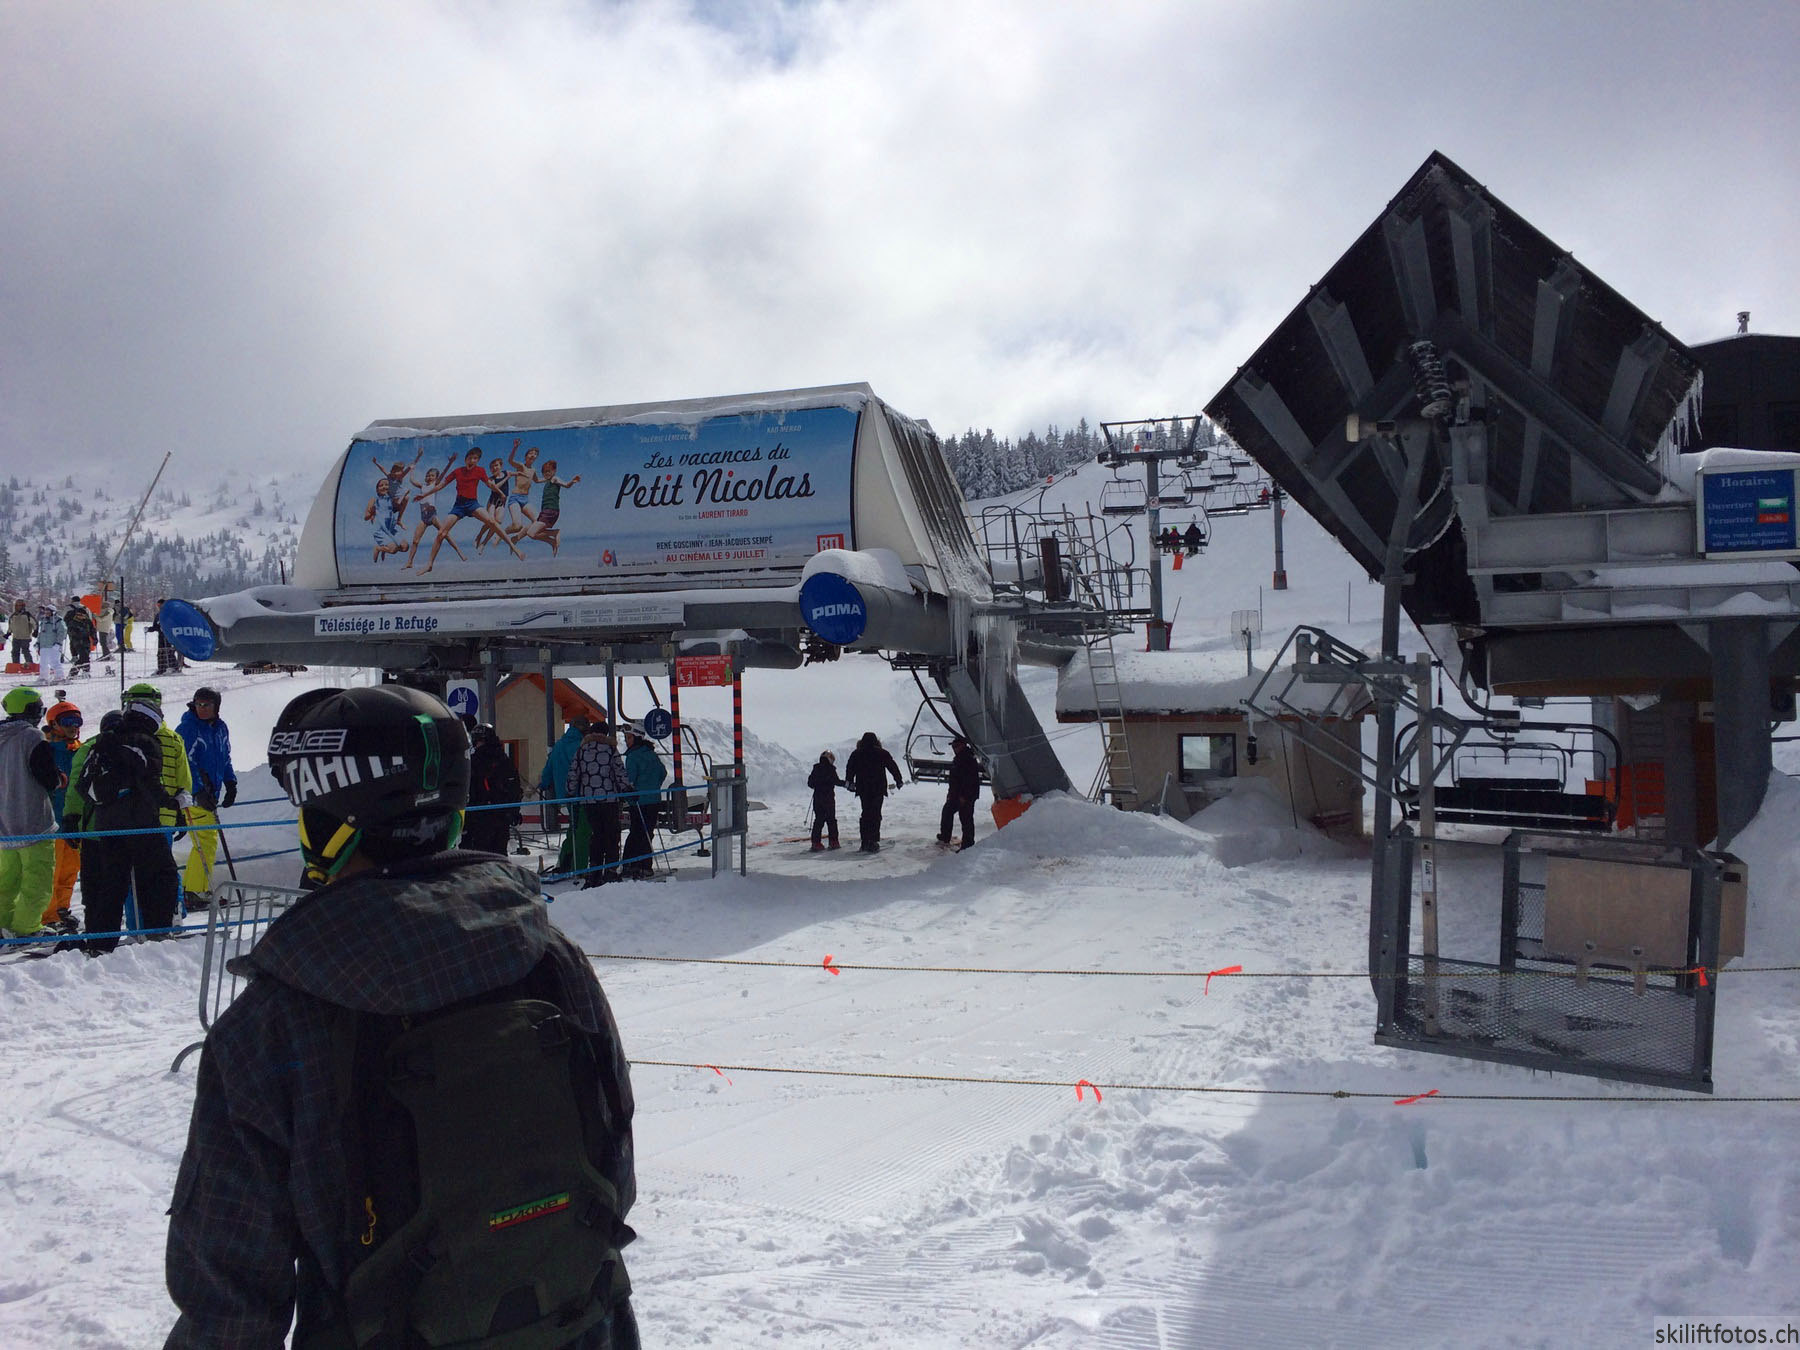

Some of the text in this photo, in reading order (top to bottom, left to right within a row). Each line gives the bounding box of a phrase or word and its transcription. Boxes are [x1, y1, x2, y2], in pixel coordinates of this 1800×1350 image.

[643, 442, 791, 469] Les vacances du
[614, 464, 816, 509] Petit Nicolas
[1720, 476, 1776, 488] Horaires
[1708, 502, 1753, 511] Ouverture
[698, 510, 725, 520] LAURENT
[726, 508, 749, 518] TIRARD
[1708, 517, 1753, 525] Fermeture
[656, 541, 672, 550] RENÉ
[673, 539, 704, 549] GOSCINNY
[708, 537, 750, 548] JEAN-JACQUES
[751, 535, 773, 545] SEMPÉ
[665, 553, 678, 562] AU
[679, 551, 711, 562] CINÉMA
[712, 551, 723, 560] LE
[725, 551, 731, 560] 9
[732, 549, 765, 559] JUILLET
[811, 603, 862, 621] POMA
[379, 617, 391, 631] le
[394, 615, 438, 632] Refuge
[171, 626, 212, 640] POMA
